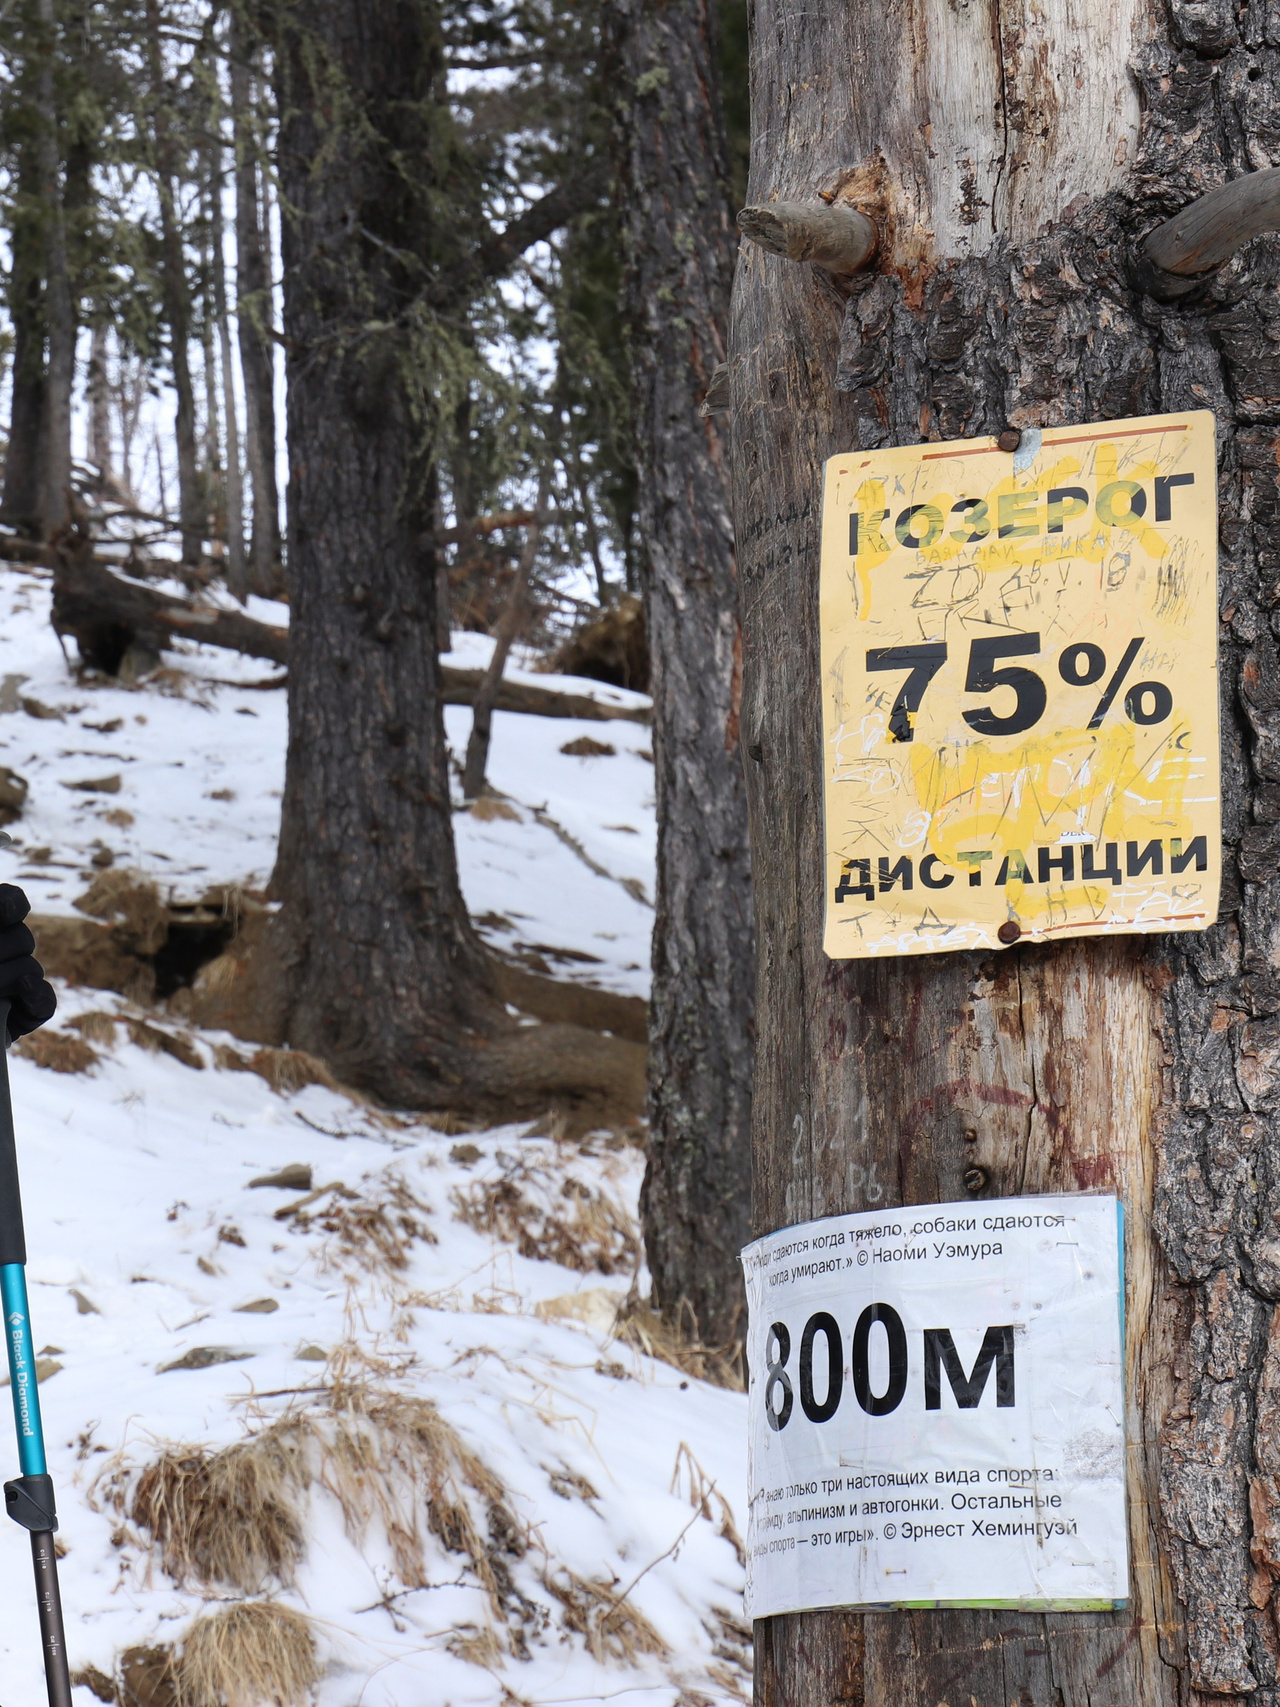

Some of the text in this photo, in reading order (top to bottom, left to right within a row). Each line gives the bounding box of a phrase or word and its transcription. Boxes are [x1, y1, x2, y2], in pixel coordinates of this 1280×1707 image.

[848, 473, 1195, 556] КОЗЕРОГ
[865, 631, 1174, 744] 75%
[834, 835, 1208, 904] ДИСТАНЦИИ
[772, 1239, 809, 1263] сдаются
[812, 1232, 845, 1250] когда
[848, 1221, 907, 1243] тяжело,
[913, 1214, 977, 1236] собаки
[982, 1214, 1066, 1234] сдаются
[791, 1256, 853, 1284] умирают.»
[872, 1243, 928, 1264] Наоми
[933, 1240, 1004, 1261] Уэмура
[11, 1328, 34, 1437] Black Diamond
[785, 1480, 819, 1501] только
[821, 1477, 844, 1496] три
[846, 1472, 929, 1492] настоящих
[934, 1467, 981, 1487] вида
[986, 1466, 1060, 1486] спорта:
[787, 1504, 846, 1525] альпинизм
[849, 1503, 858, 1517] и
[861, 1495, 945, 1517] автогонки.
[951, 1492, 1062, 1511] Остальные
[769, 1536, 796, 1556] спорта
[811, 1531, 832, 1547] это
[901, 1520, 963, 1541] Эрнест
[970, 1517, 1079, 1539] Хемингуэй
